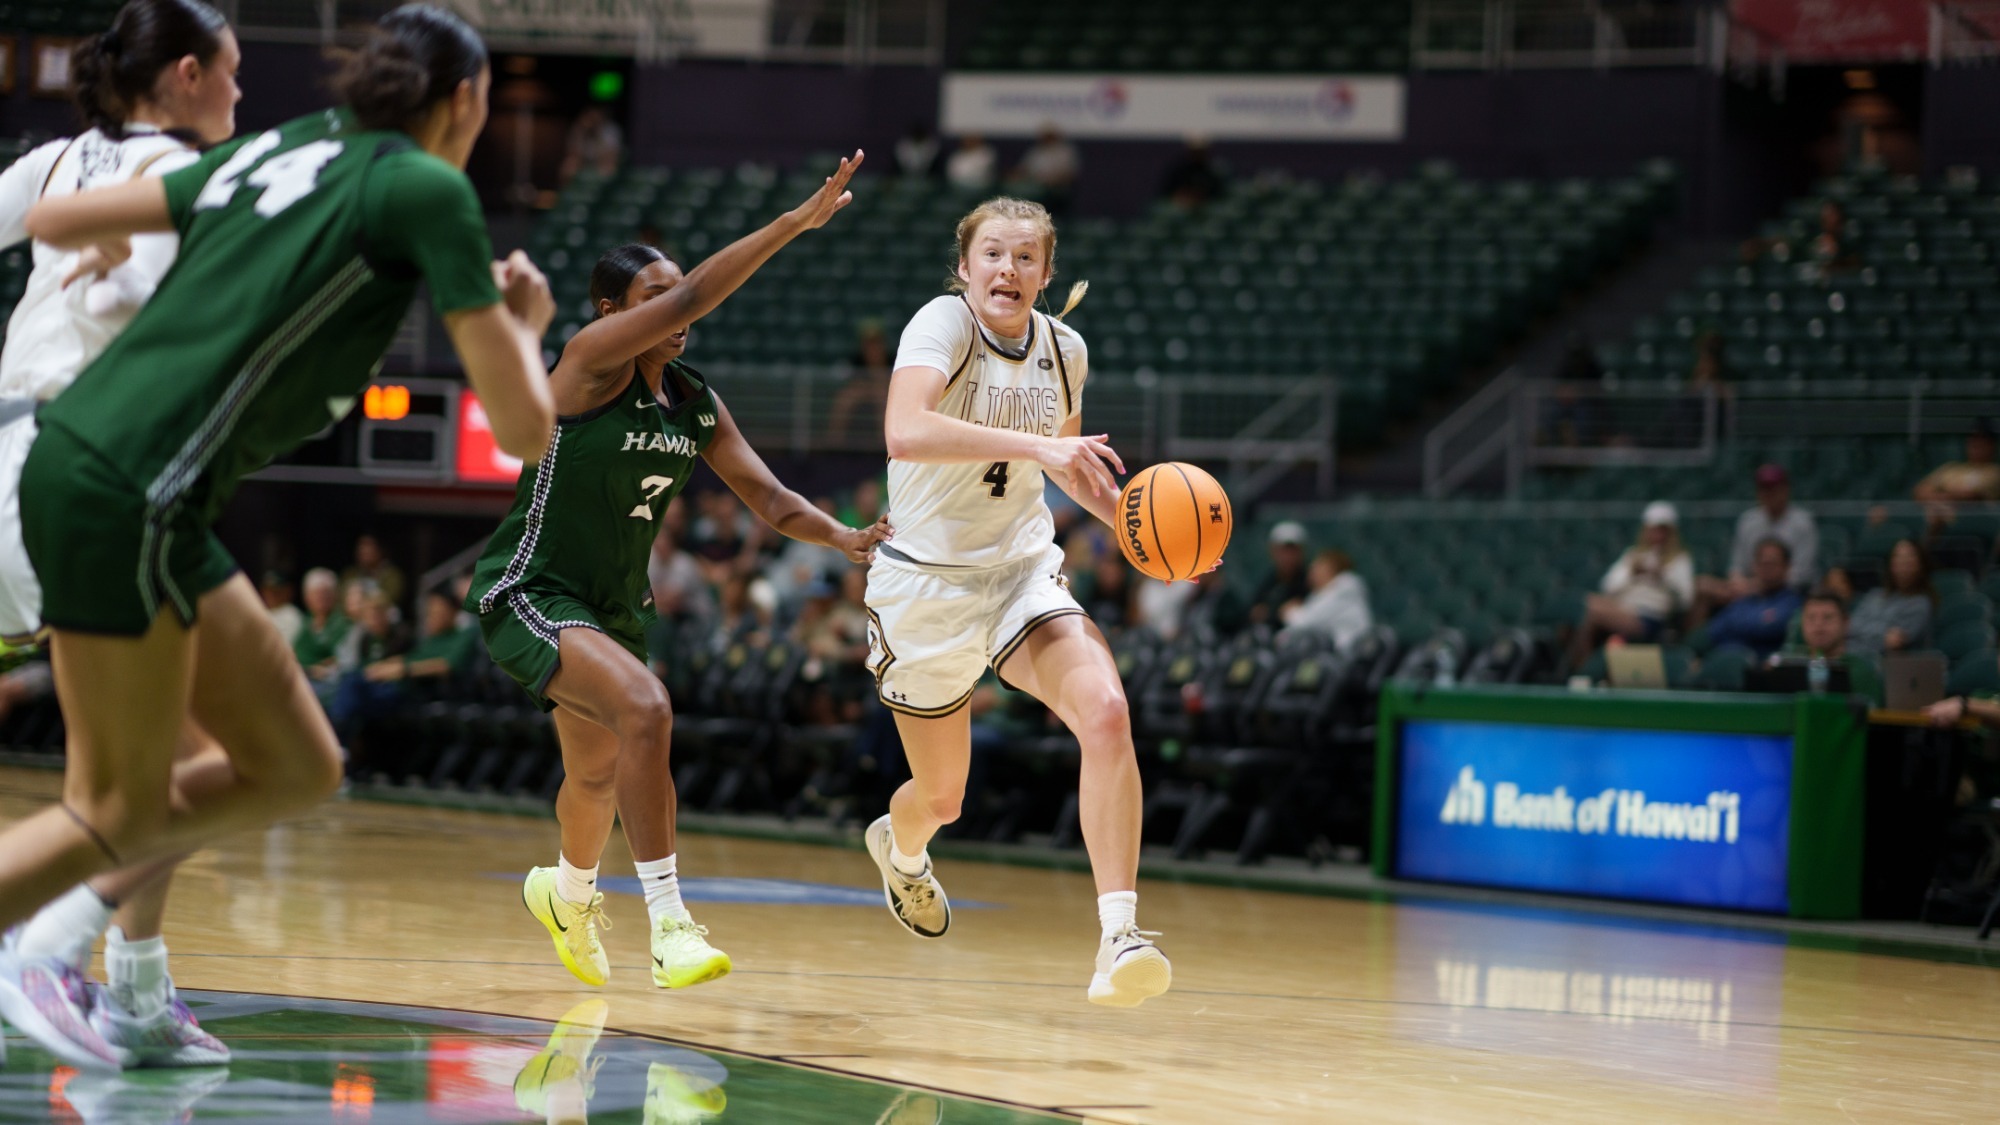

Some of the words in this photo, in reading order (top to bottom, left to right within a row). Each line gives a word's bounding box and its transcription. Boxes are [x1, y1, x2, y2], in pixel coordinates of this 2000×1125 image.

[191, 128, 345, 220] 14
[961, 381, 1058, 437] LIONS
[980, 460, 1010, 500] 4
[1125, 485, 1150, 564] Wilson
[1493, 781, 1575, 833] Bank
[1576, 788, 1617, 835] of
